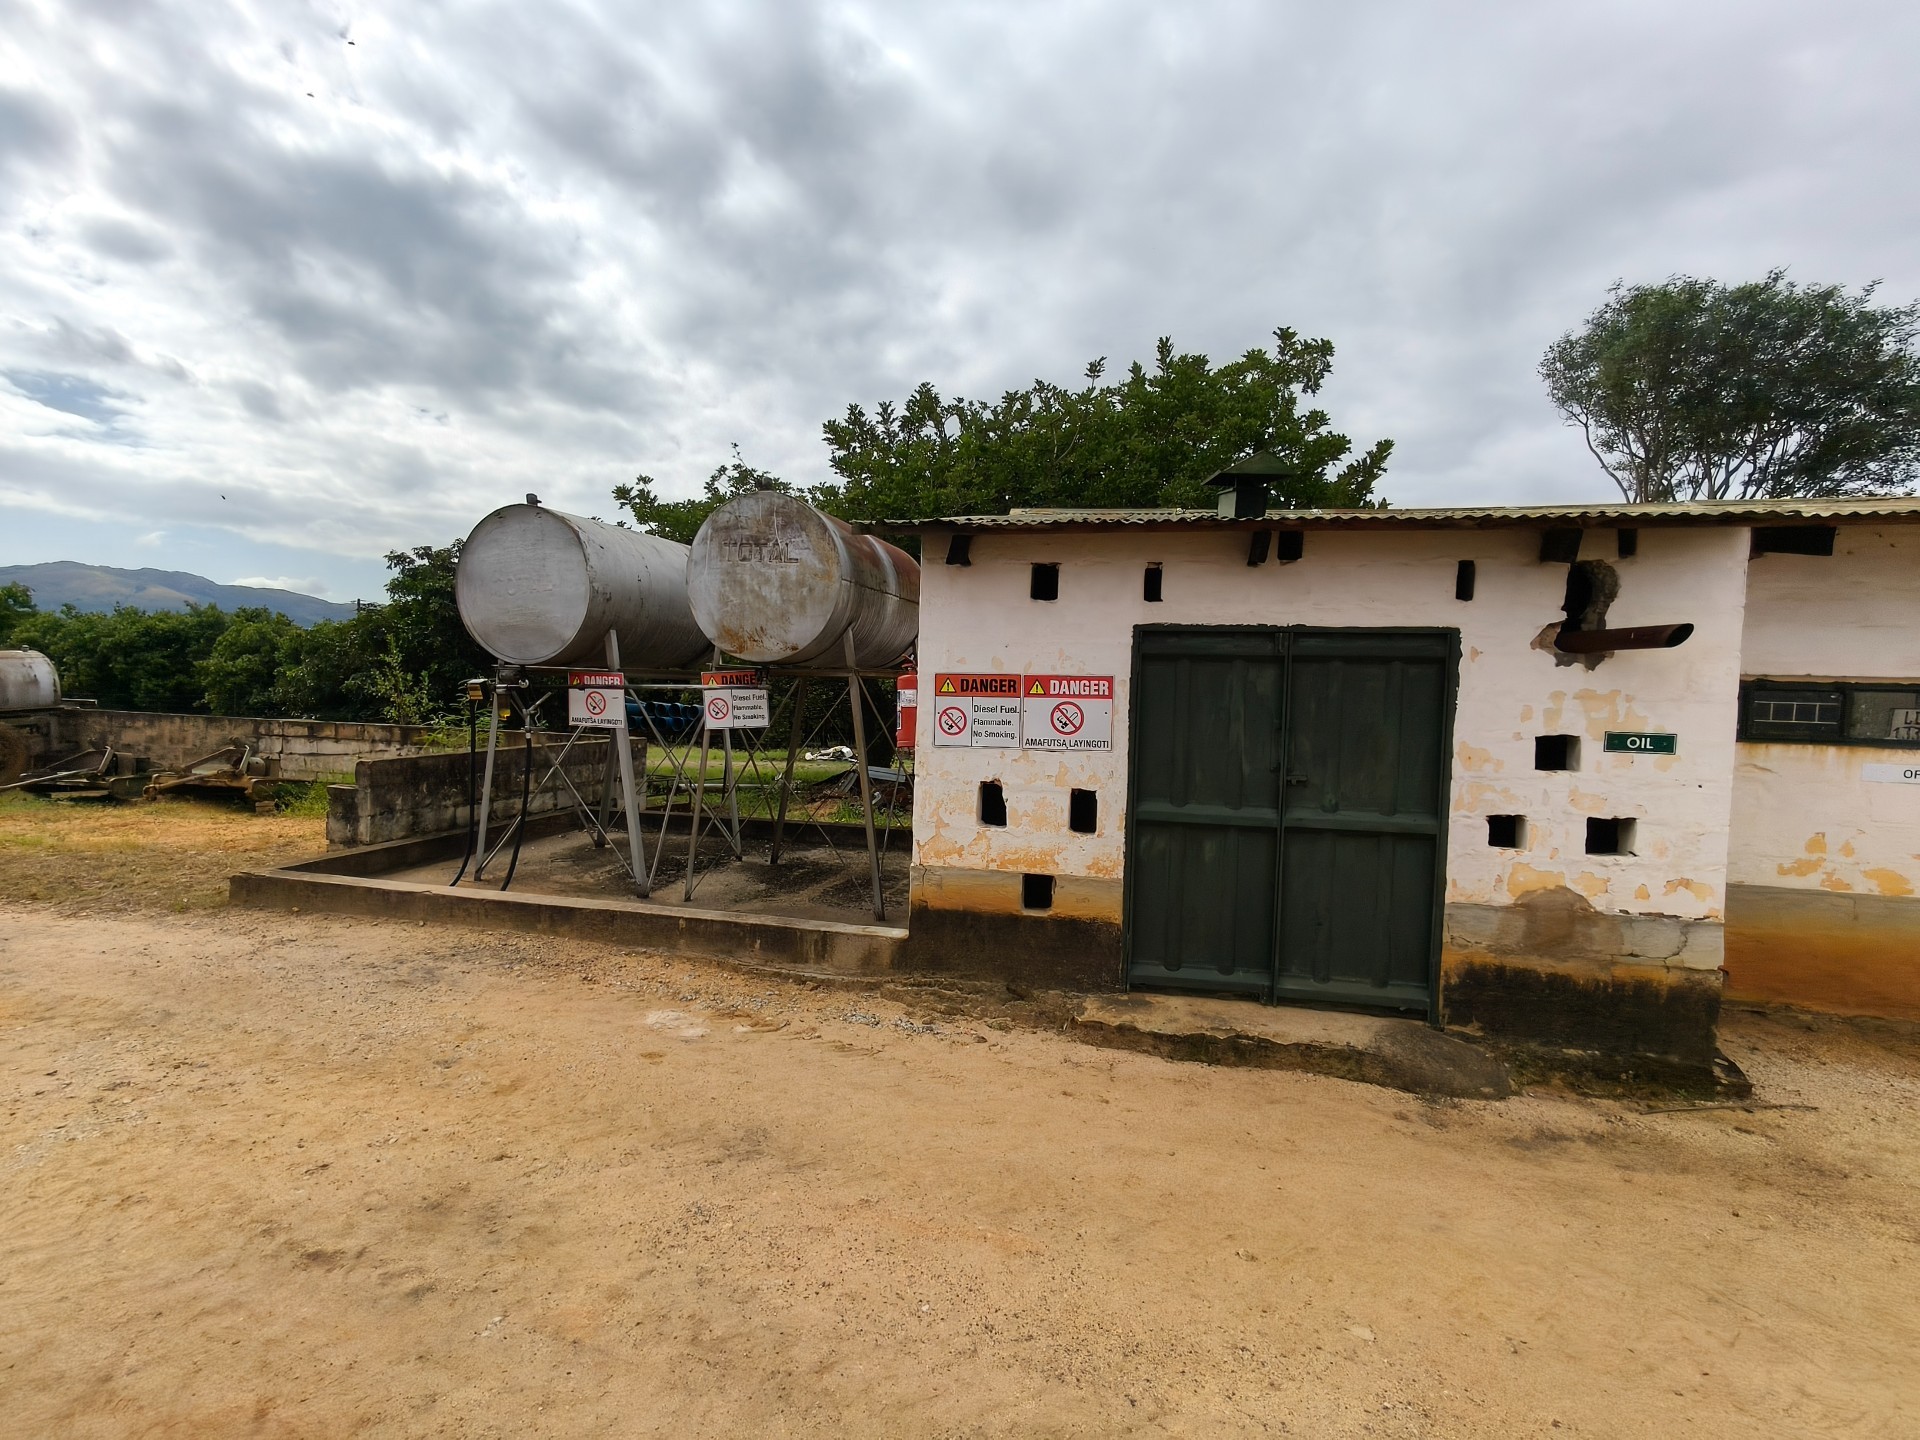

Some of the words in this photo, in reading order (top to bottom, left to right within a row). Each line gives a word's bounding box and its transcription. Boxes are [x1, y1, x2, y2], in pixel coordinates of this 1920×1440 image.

[723, 540, 799, 563] TOTAL
[584, 675, 621, 685] DANGER
[721, 675, 760, 685] DANGE
[960, 678, 1017, 693] DANGER
[1050, 679, 1109, 696] DANGER
[752, 693, 767, 701] Fuel.
[973, 704, 998, 713] Diesel
[1000, 705, 1020, 714] Fuel.
[571, 716, 597, 724] AMAFUTSA
[973, 717, 1014, 726] Flammable.
[973, 730, 983, 738] No
[984, 730, 1017, 740] Smoking.
[1024, 738, 1067, 747] AMAFUTSA
[1069, 739, 1109, 749] LAYINGOTI
[1626, 736, 1654, 749] OIL
